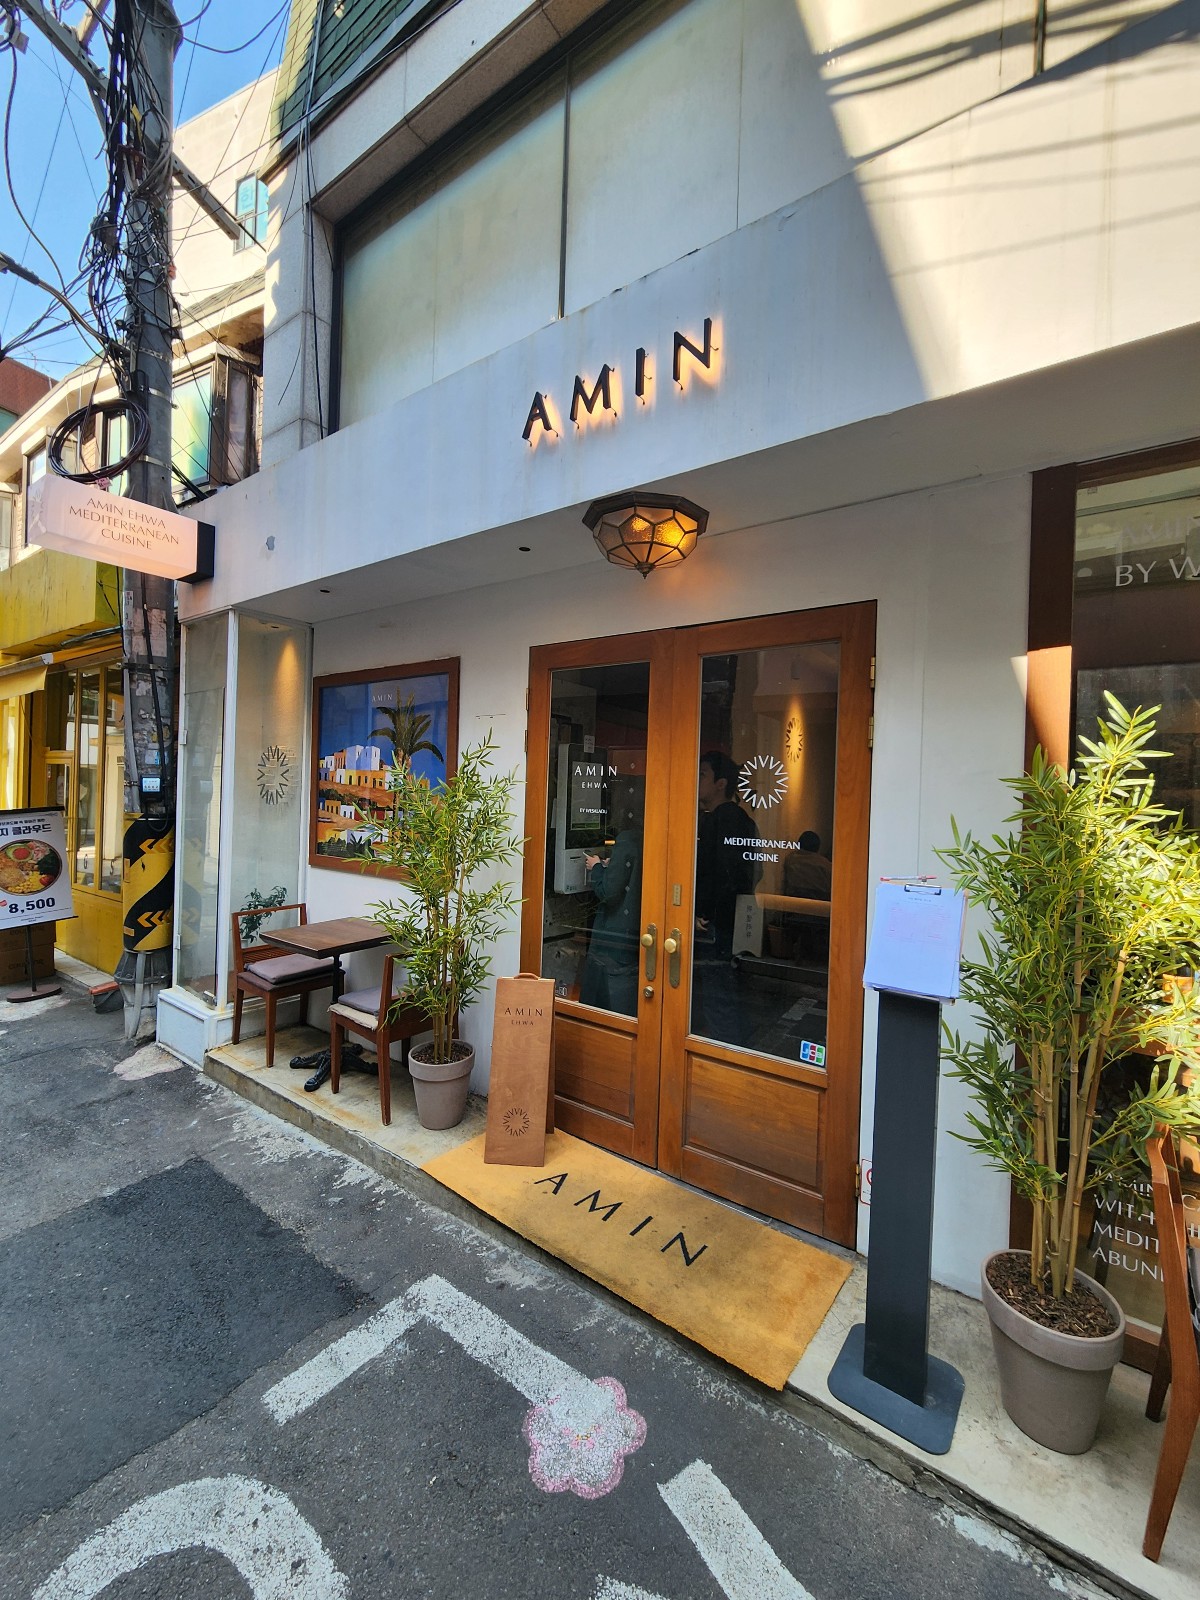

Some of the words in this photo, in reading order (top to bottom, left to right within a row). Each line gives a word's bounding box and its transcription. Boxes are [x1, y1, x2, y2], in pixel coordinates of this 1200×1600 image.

[522, 317, 713, 440] AMIN
[87, 498, 124, 516] AMIN
[128, 510, 166, 529] EHWA
[69, 505, 179, 544] MEDITERRANEAN
[101, 528, 152, 550] CUISINE
[1115, 560, 1157, 587] BY
[371, 693, 393, 703] AMIN
[574, 765, 618, 777] AMIN
[581, 781, 608, 789] EHWA
[12, 823, 52, 836] 클라우드
[723, 836, 801, 850] MEDITERRANEAN
[742, 851, 779, 863] CUISINE
[8, 897, 56, 914] 8,500
[504, 1007, 543, 1016] AMIN
[1093, 1193, 1156, 1226] WITH
[534, 1173, 708, 1267] AMIN
[1092, 1246, 1164, 1283] ABUN
